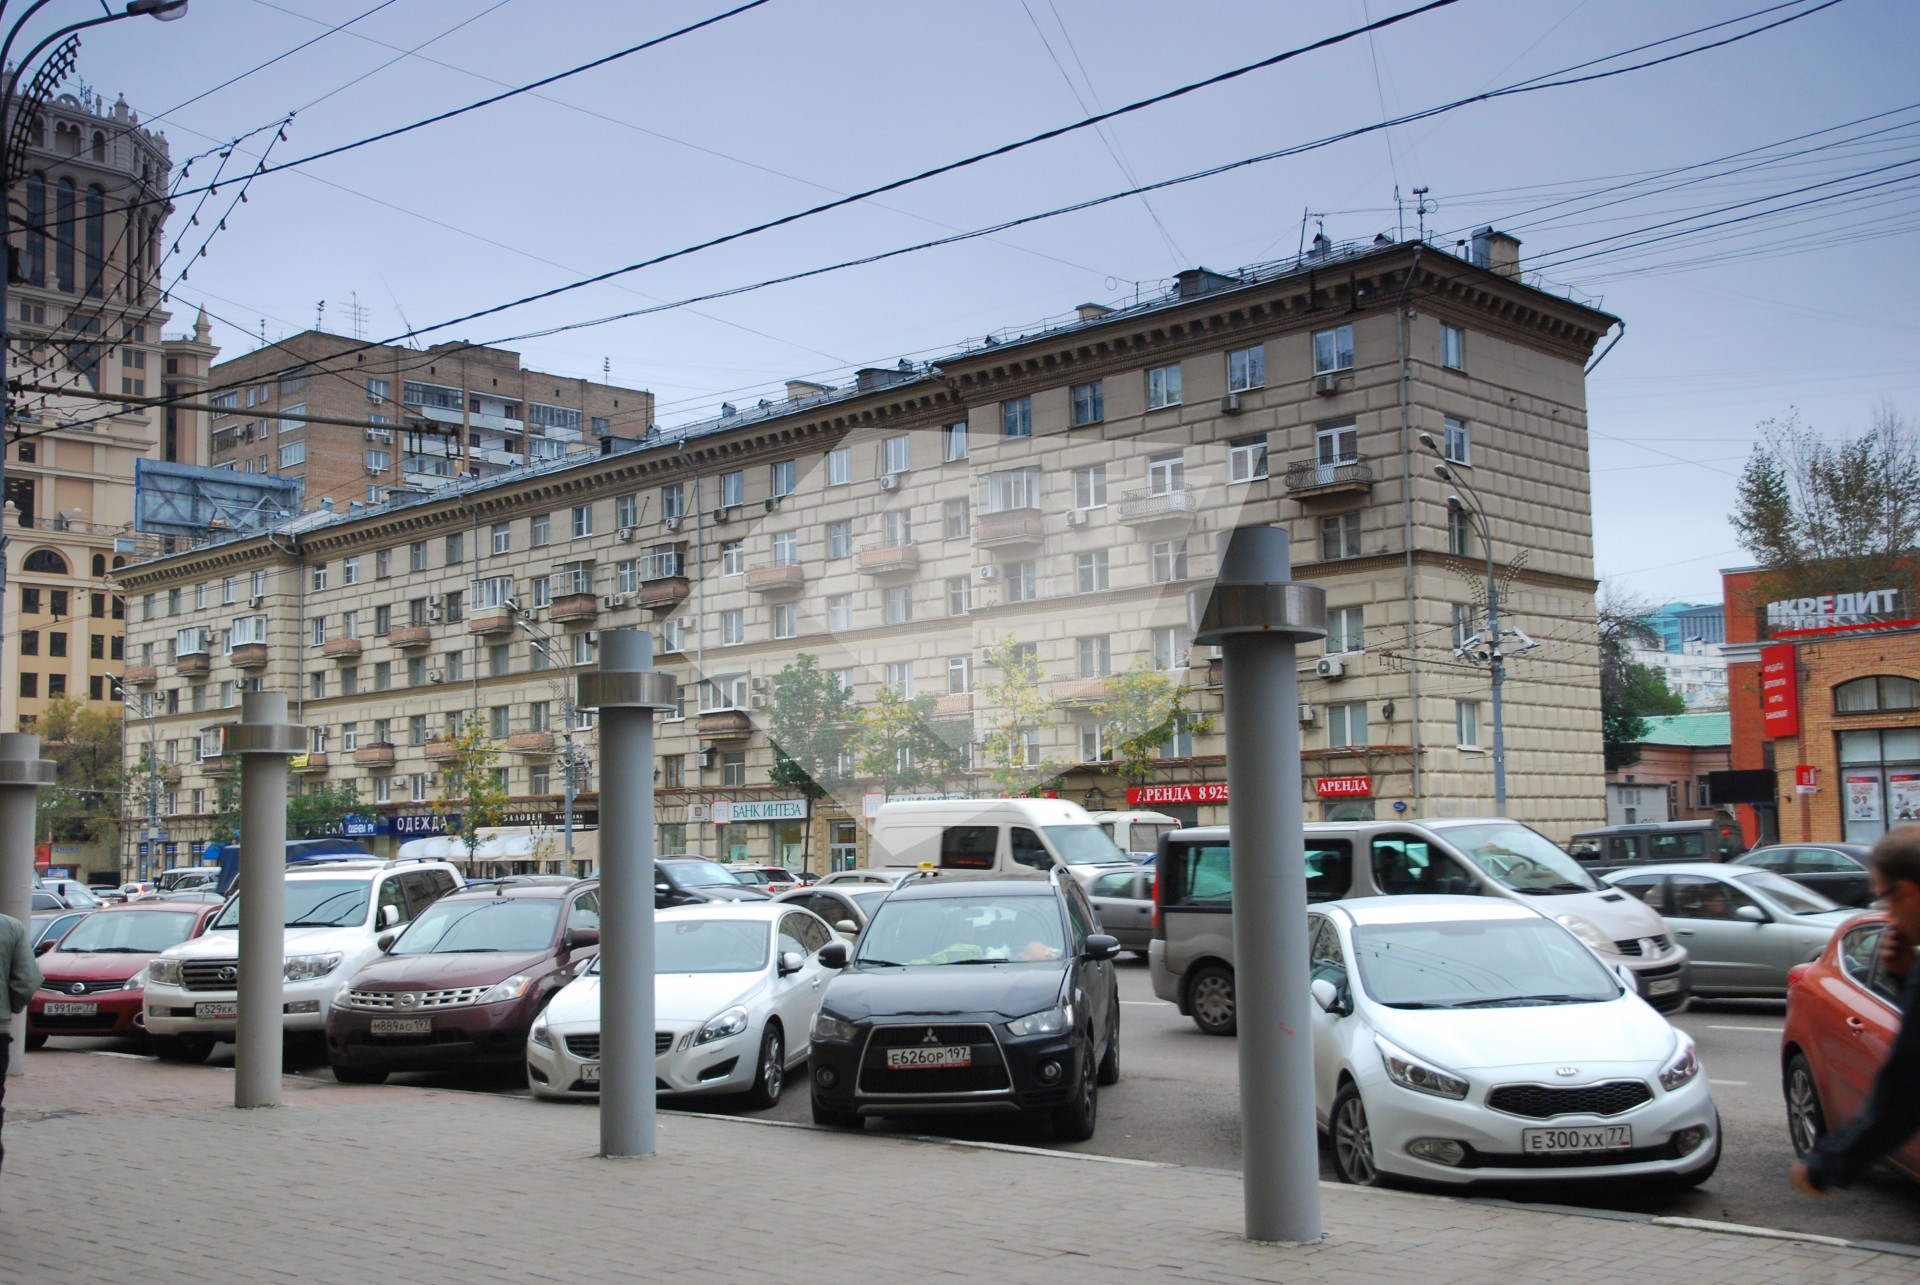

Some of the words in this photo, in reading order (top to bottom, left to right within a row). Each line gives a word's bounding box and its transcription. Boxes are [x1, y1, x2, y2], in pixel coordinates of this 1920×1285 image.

[1319, 780, 1368, 792] АРЕНДА
[1136, 787, 1192, 802] АРЕНДА
[1198, 787, 1207, 800] 8
[733, 804, 760, 818] БАНК
[763, 802, 802, 817] ИНТЕЗА
[397, 816, 448, 832] ОДЕЖДА
[947, 1047, 967, 1059] 197
[1557, 1067, 1578, 1076] KIA
[1607, 1127, 1625, 1141] 77
